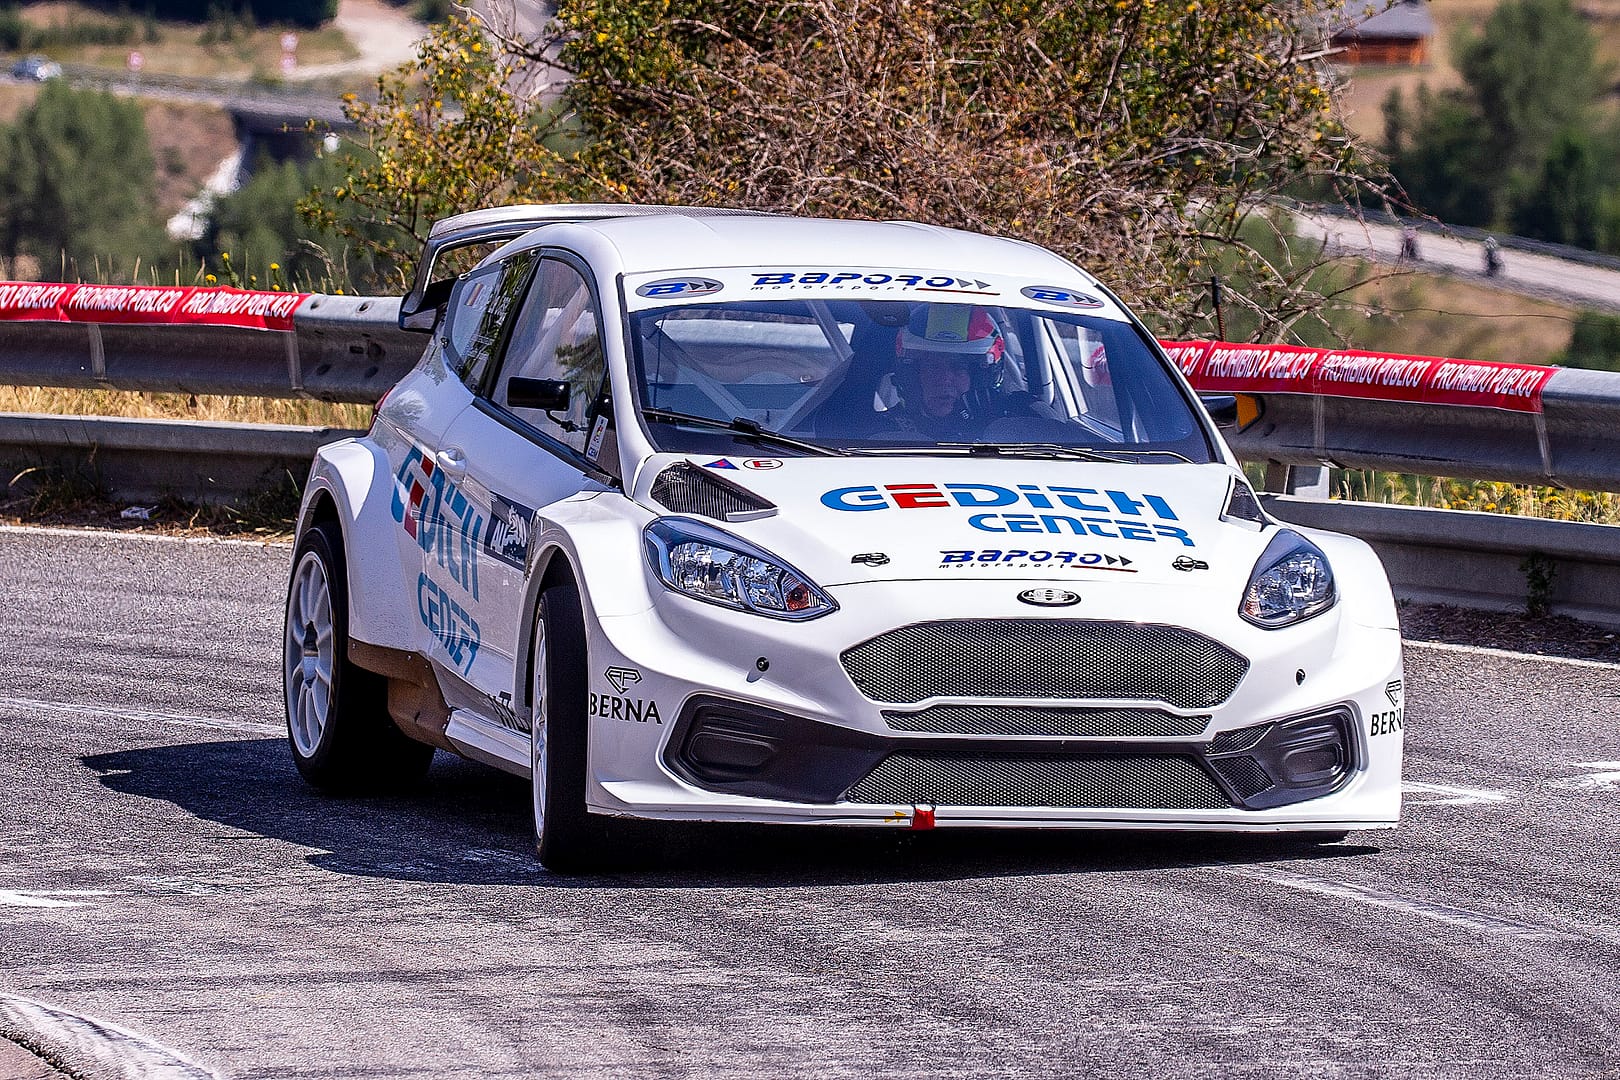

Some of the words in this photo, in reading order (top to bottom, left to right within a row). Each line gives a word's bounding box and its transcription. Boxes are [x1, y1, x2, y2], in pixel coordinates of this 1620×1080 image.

[750, 284, 909, 292] motorsport
[1205, 349, 1269, 378] PROHIBIDO
[590, 692, 662, 724] BERNA
